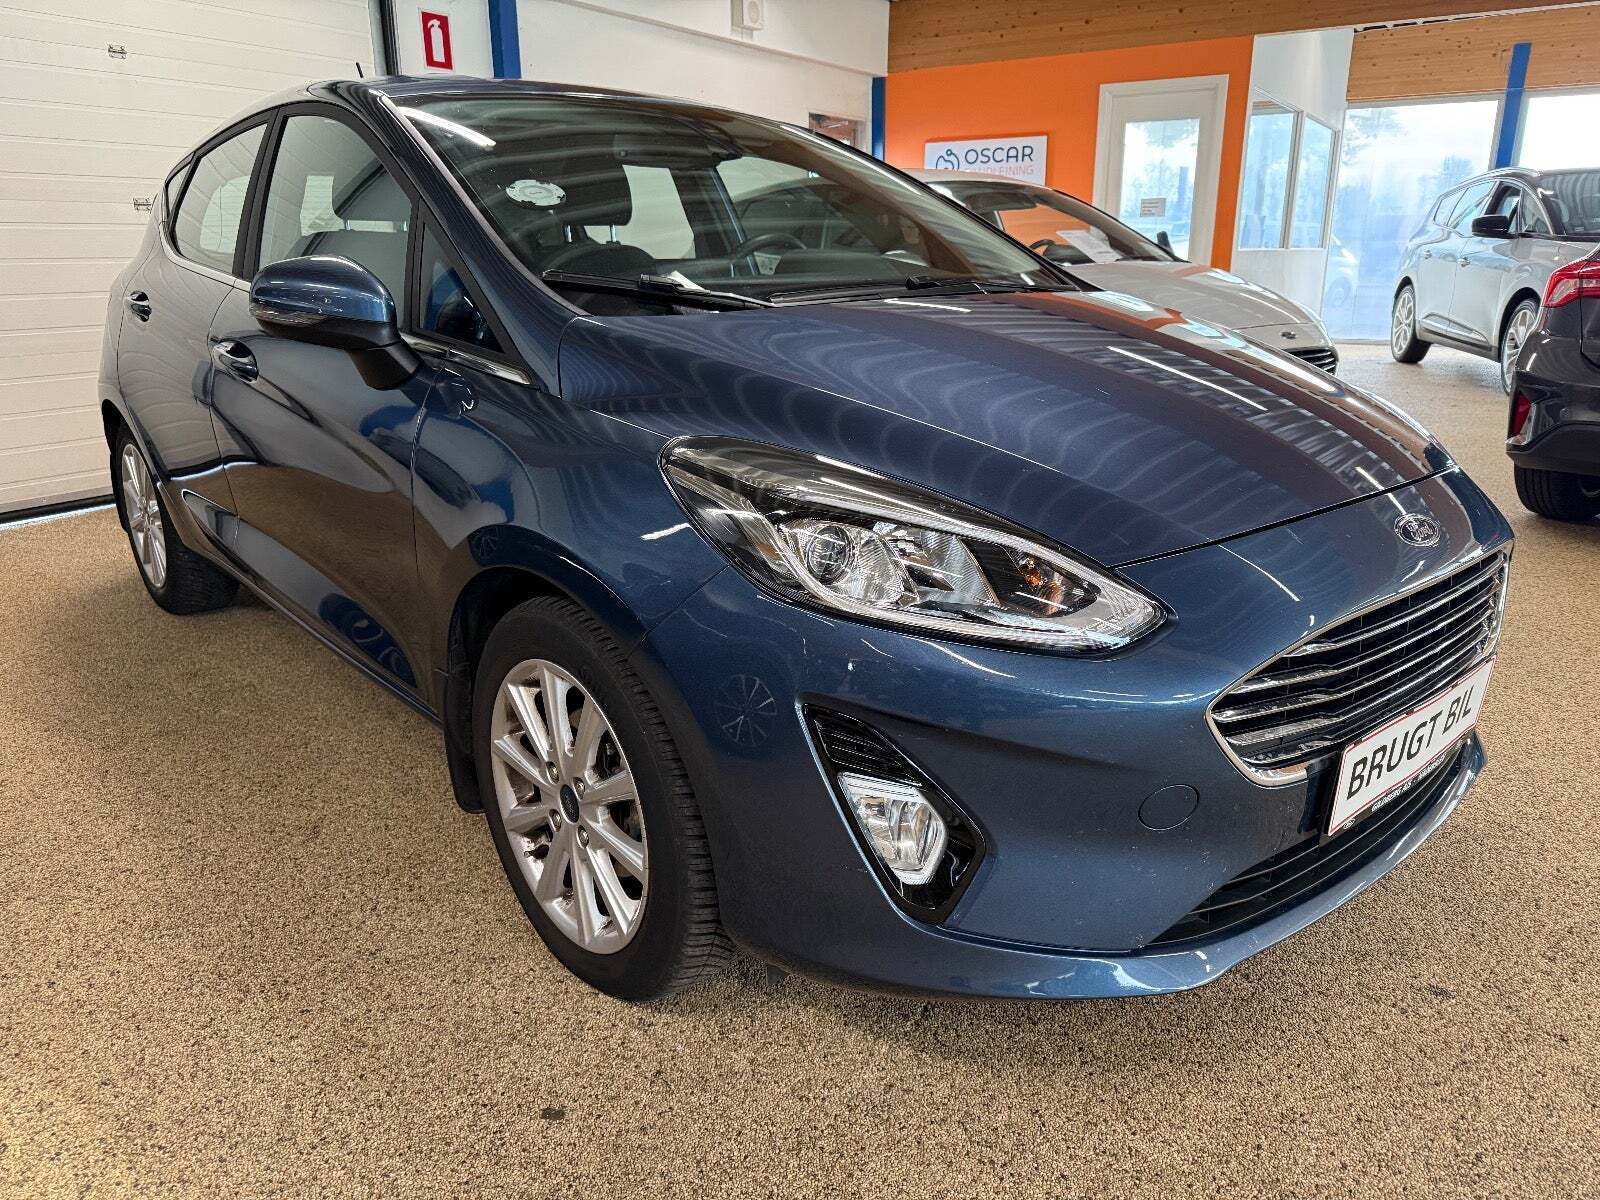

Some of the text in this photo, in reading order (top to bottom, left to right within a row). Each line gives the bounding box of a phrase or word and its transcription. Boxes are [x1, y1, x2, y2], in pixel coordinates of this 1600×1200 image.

[965, 146, 1033, 164] OSCAR
[1347, 709, 1443, 800] BRUGT
[1442, 685, 1474, 735] BIL
